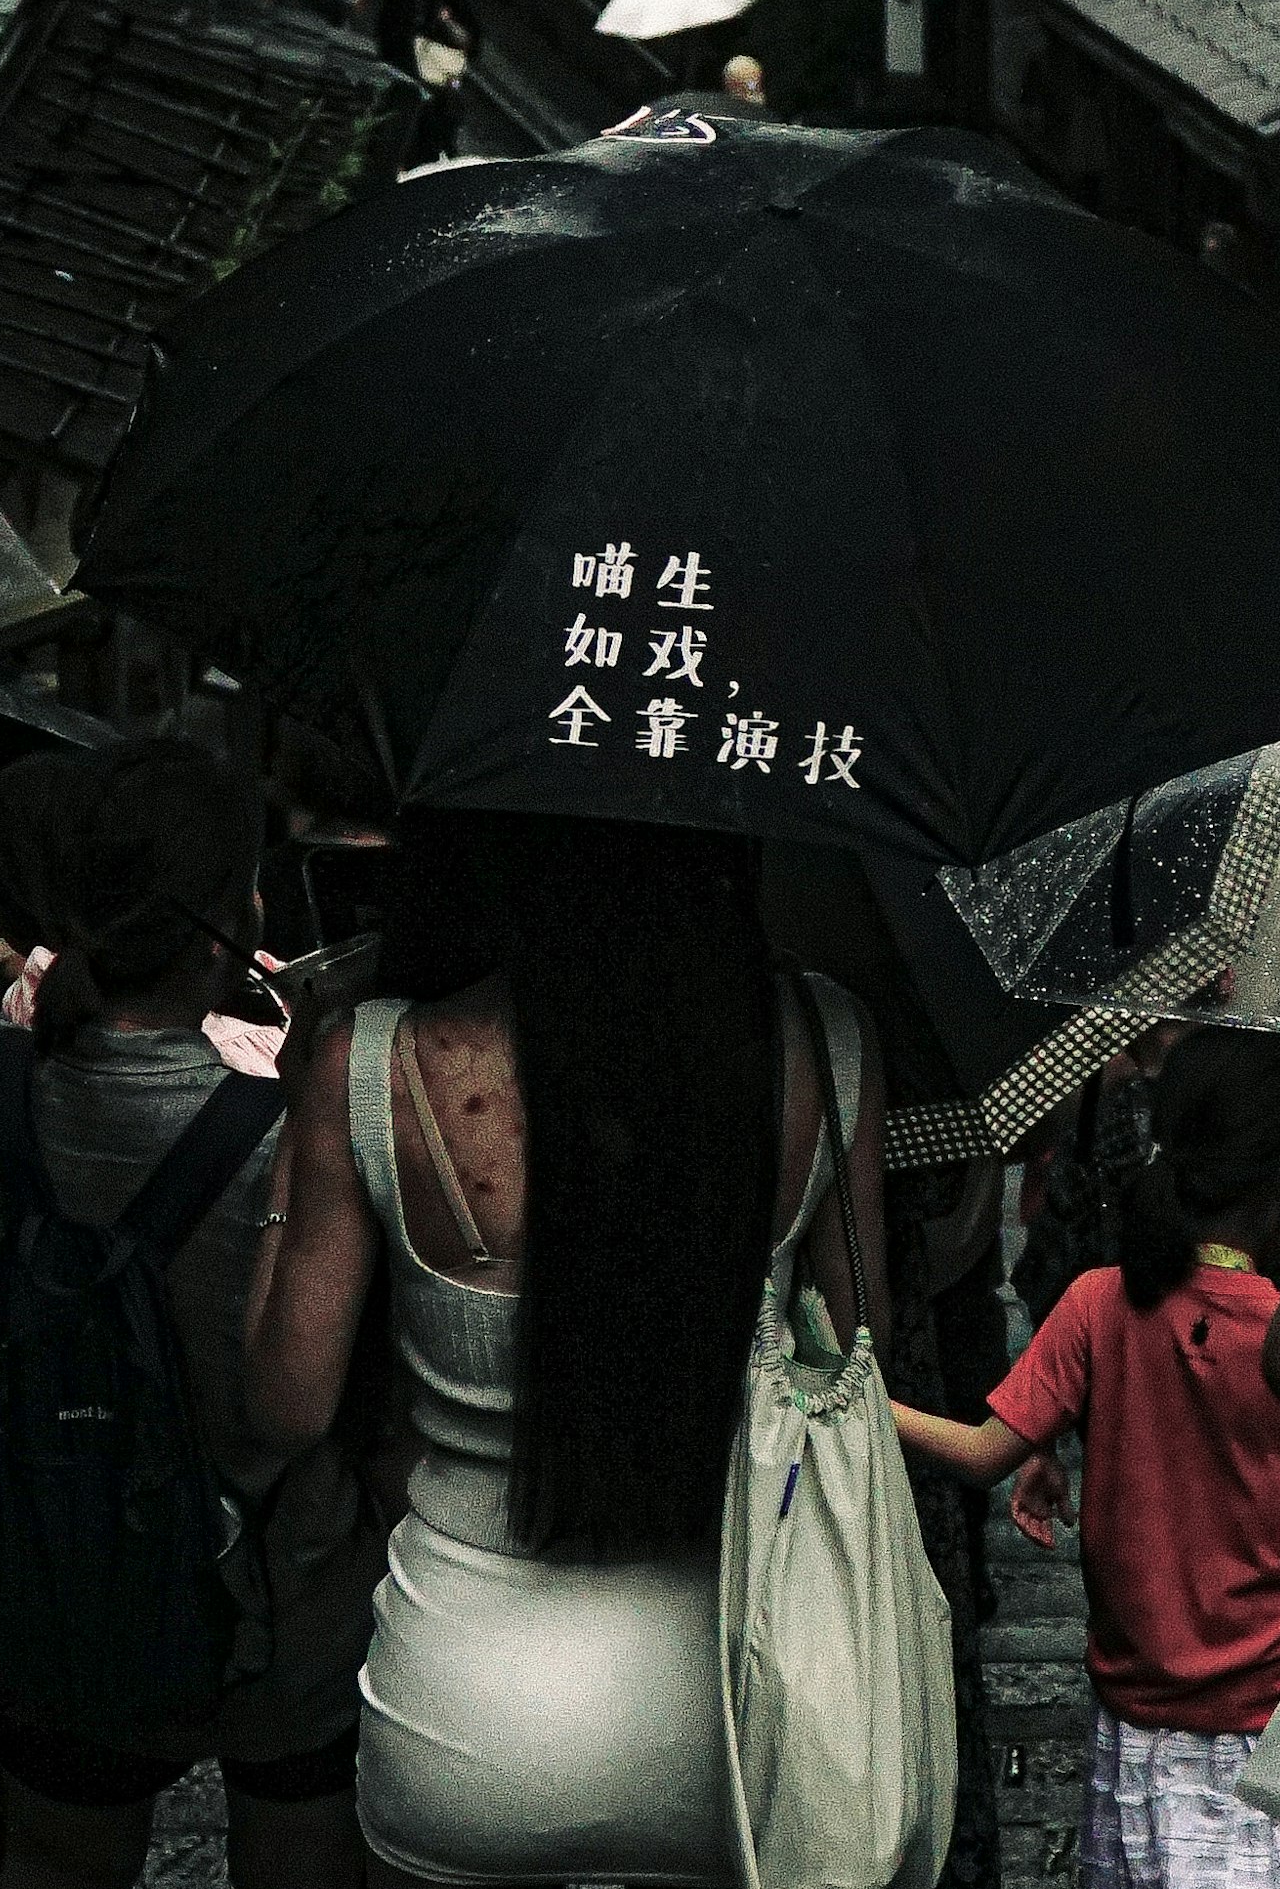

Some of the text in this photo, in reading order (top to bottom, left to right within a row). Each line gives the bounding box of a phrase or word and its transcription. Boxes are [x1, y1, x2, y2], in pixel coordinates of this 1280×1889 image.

[572, 541, 716, 612] 喵生
[548, 685, 865, 790] 全靠演技
